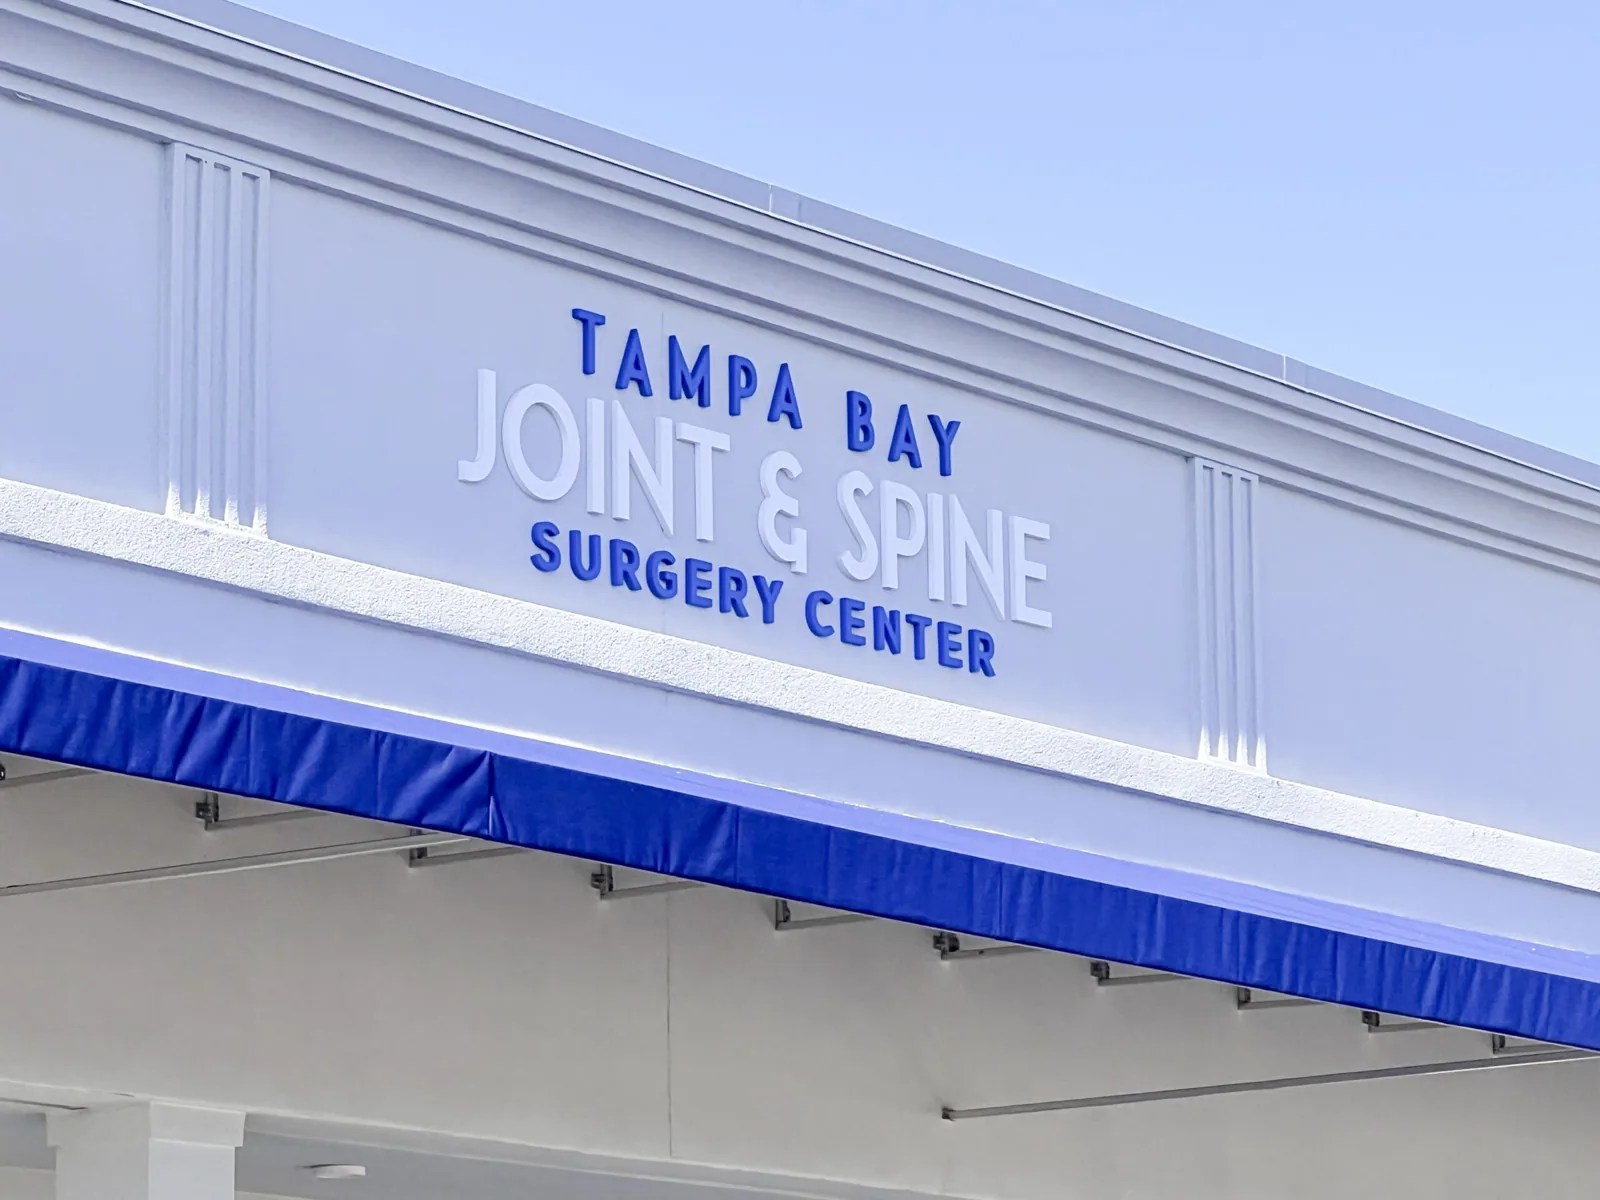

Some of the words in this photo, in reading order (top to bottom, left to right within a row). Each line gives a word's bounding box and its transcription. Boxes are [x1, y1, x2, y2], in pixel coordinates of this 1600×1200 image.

[571, 308, 803, 430] TAMPA
[845, 390, 961, 477] BAY
[457, 368, 731, 542] JOINT
[758, 450, 808, 575] &
[836, 470, 1053, 629] SPINE
[529, 521, 785, 625] SURGERY
[804, 590, 996, 678] CENTER
